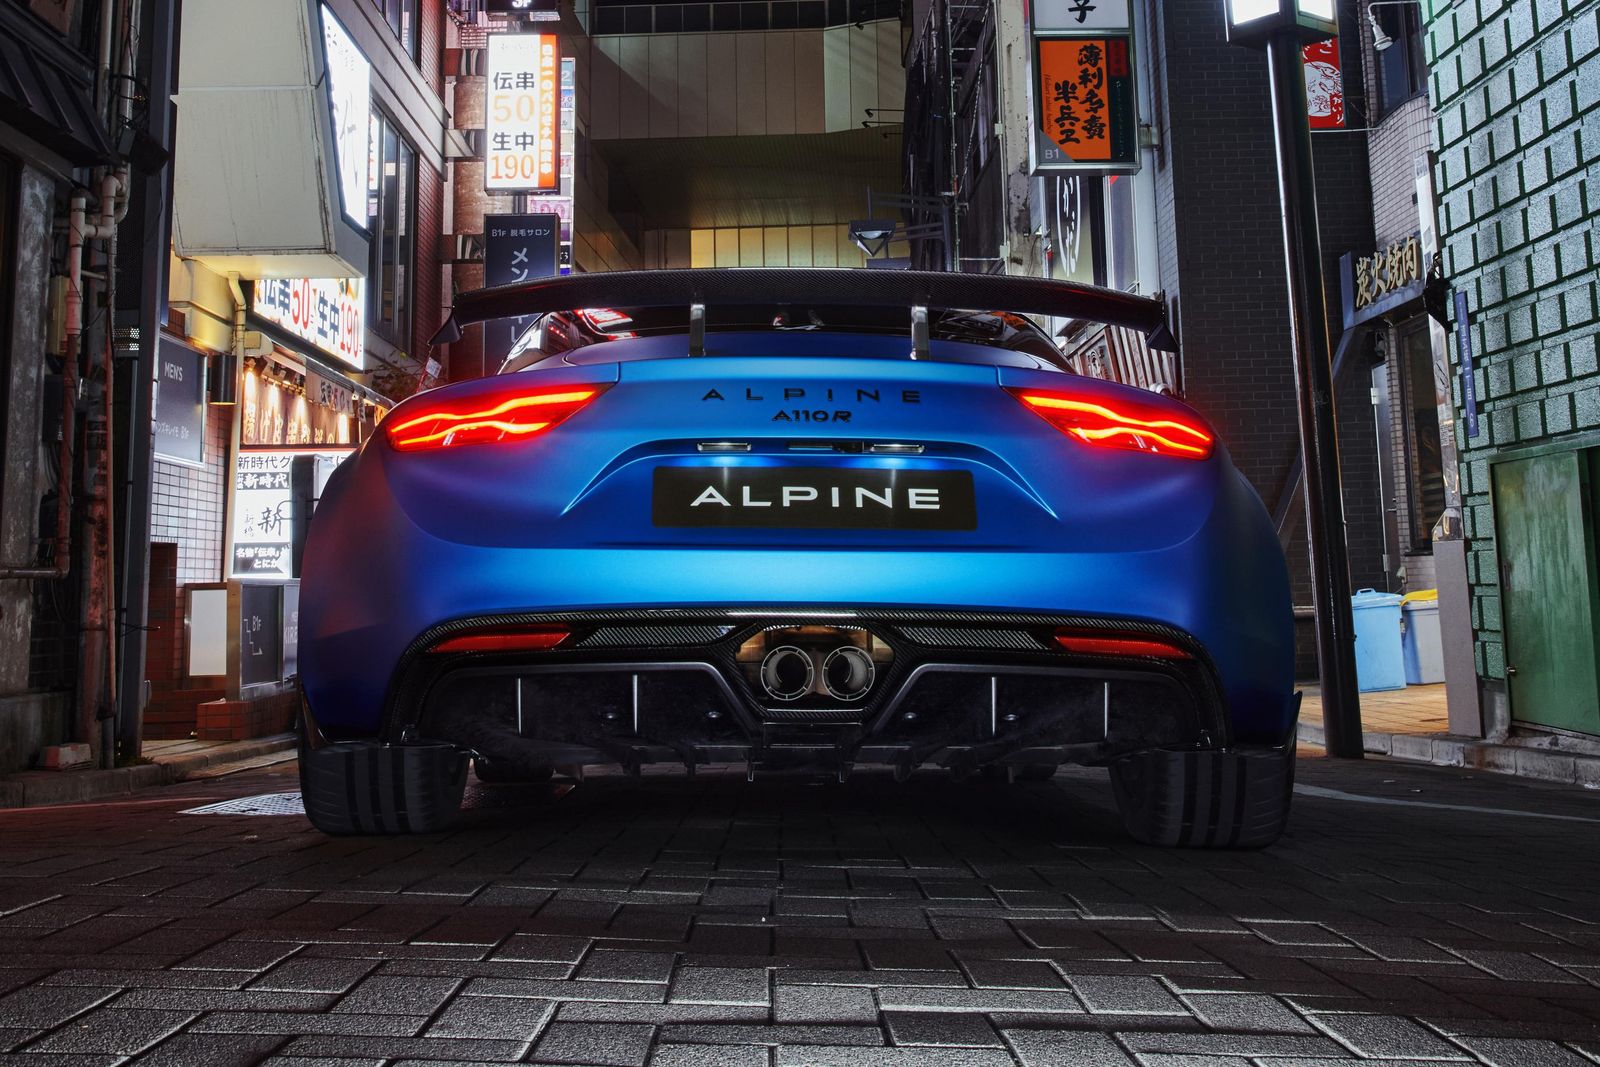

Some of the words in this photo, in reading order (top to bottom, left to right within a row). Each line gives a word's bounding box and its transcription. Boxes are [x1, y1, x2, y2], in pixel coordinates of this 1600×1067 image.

[493, 71, 535, 90] 伝串
[493, 94, 535, 123] 50
[492, 131, 534, 151] 生中
[1045, 148, 1060, 159] B1
[491, 154, 535, 179] 190
[491, 228, 507, 237] B1F
[1356, 235, 1418, 308] 炭火焼肉
[164, 361, 183, 382] MEN'S
[702, 387, 921, 403] ALPINE
[772, 409, 853, 423] A110R
[243, 472, 289, 489] 新時代
[689, 485, 942, 510] ALPINE
